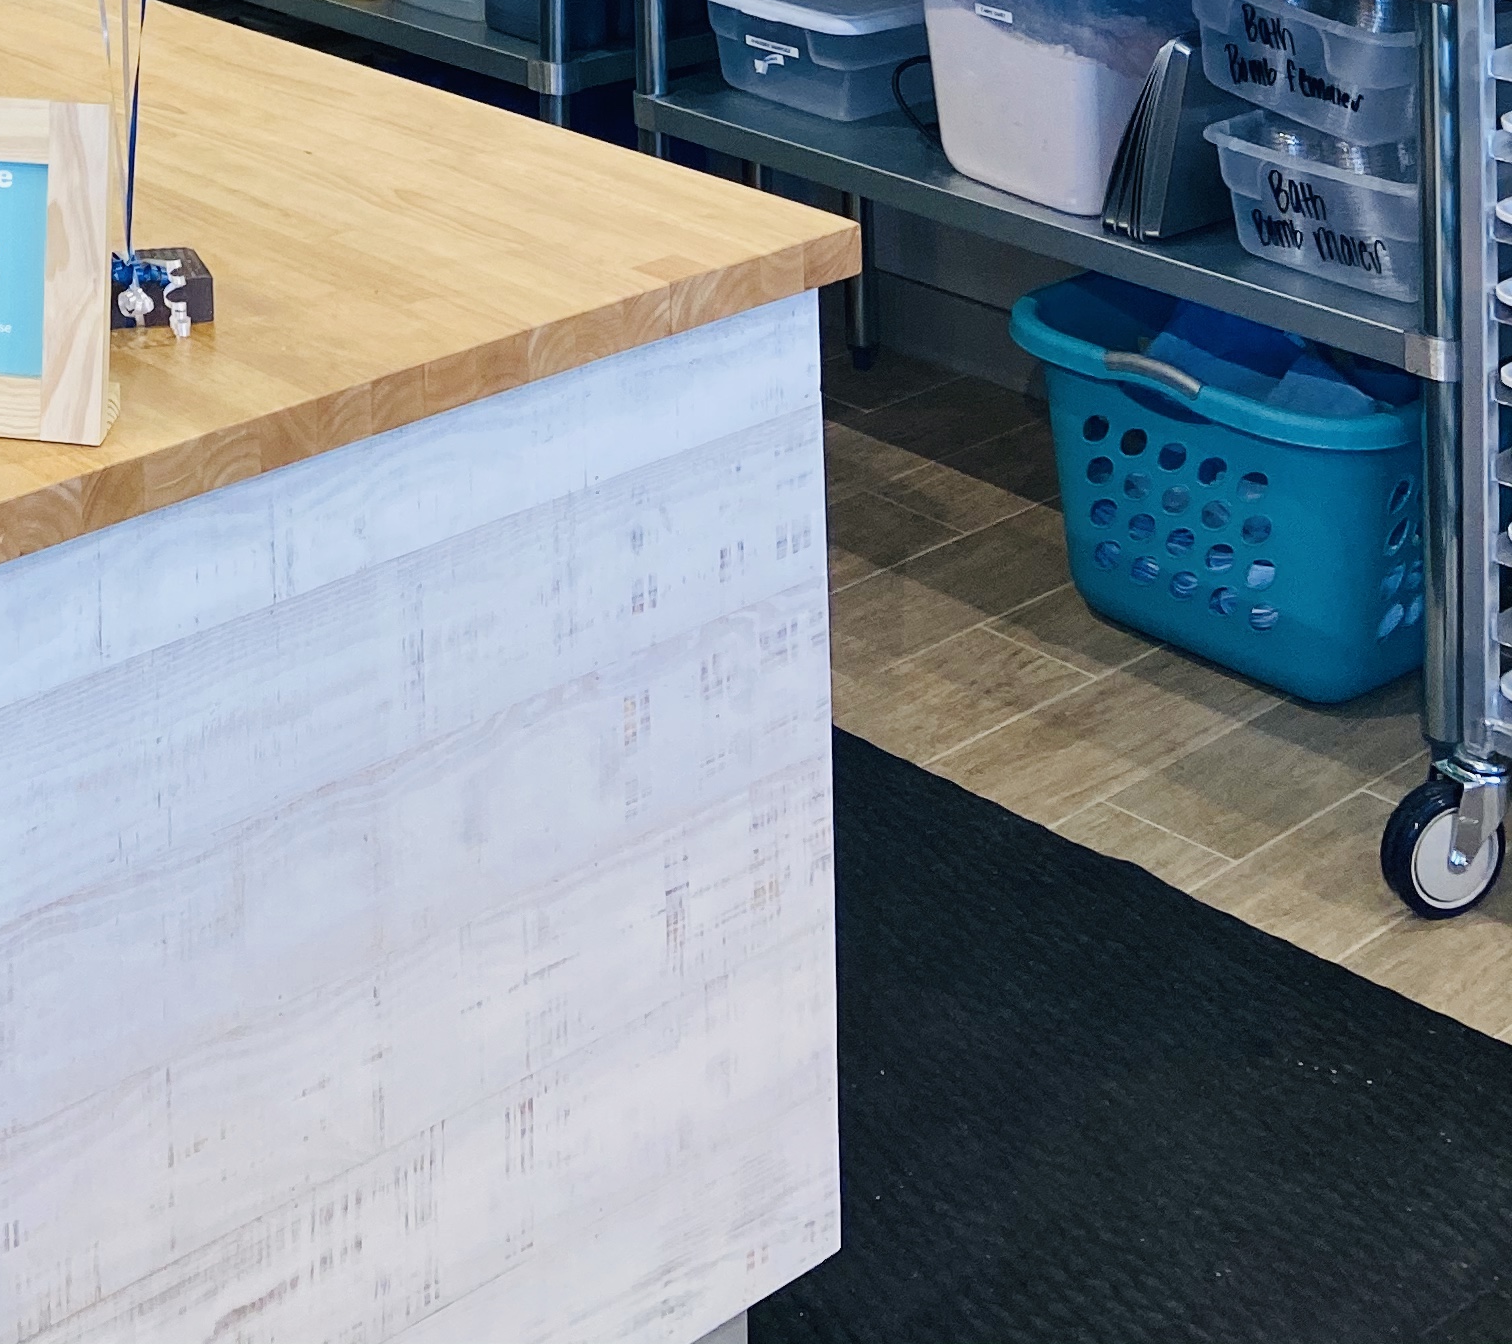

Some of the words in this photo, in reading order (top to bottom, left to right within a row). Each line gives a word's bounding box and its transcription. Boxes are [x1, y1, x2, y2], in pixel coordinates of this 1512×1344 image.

[1241, 3, 1296, 56] Bath
[1224, 43, 1278, 87] Bomb
[1268, 169, 1327, 221] Bath
[1251, 208, 1304, 250] Bomb
